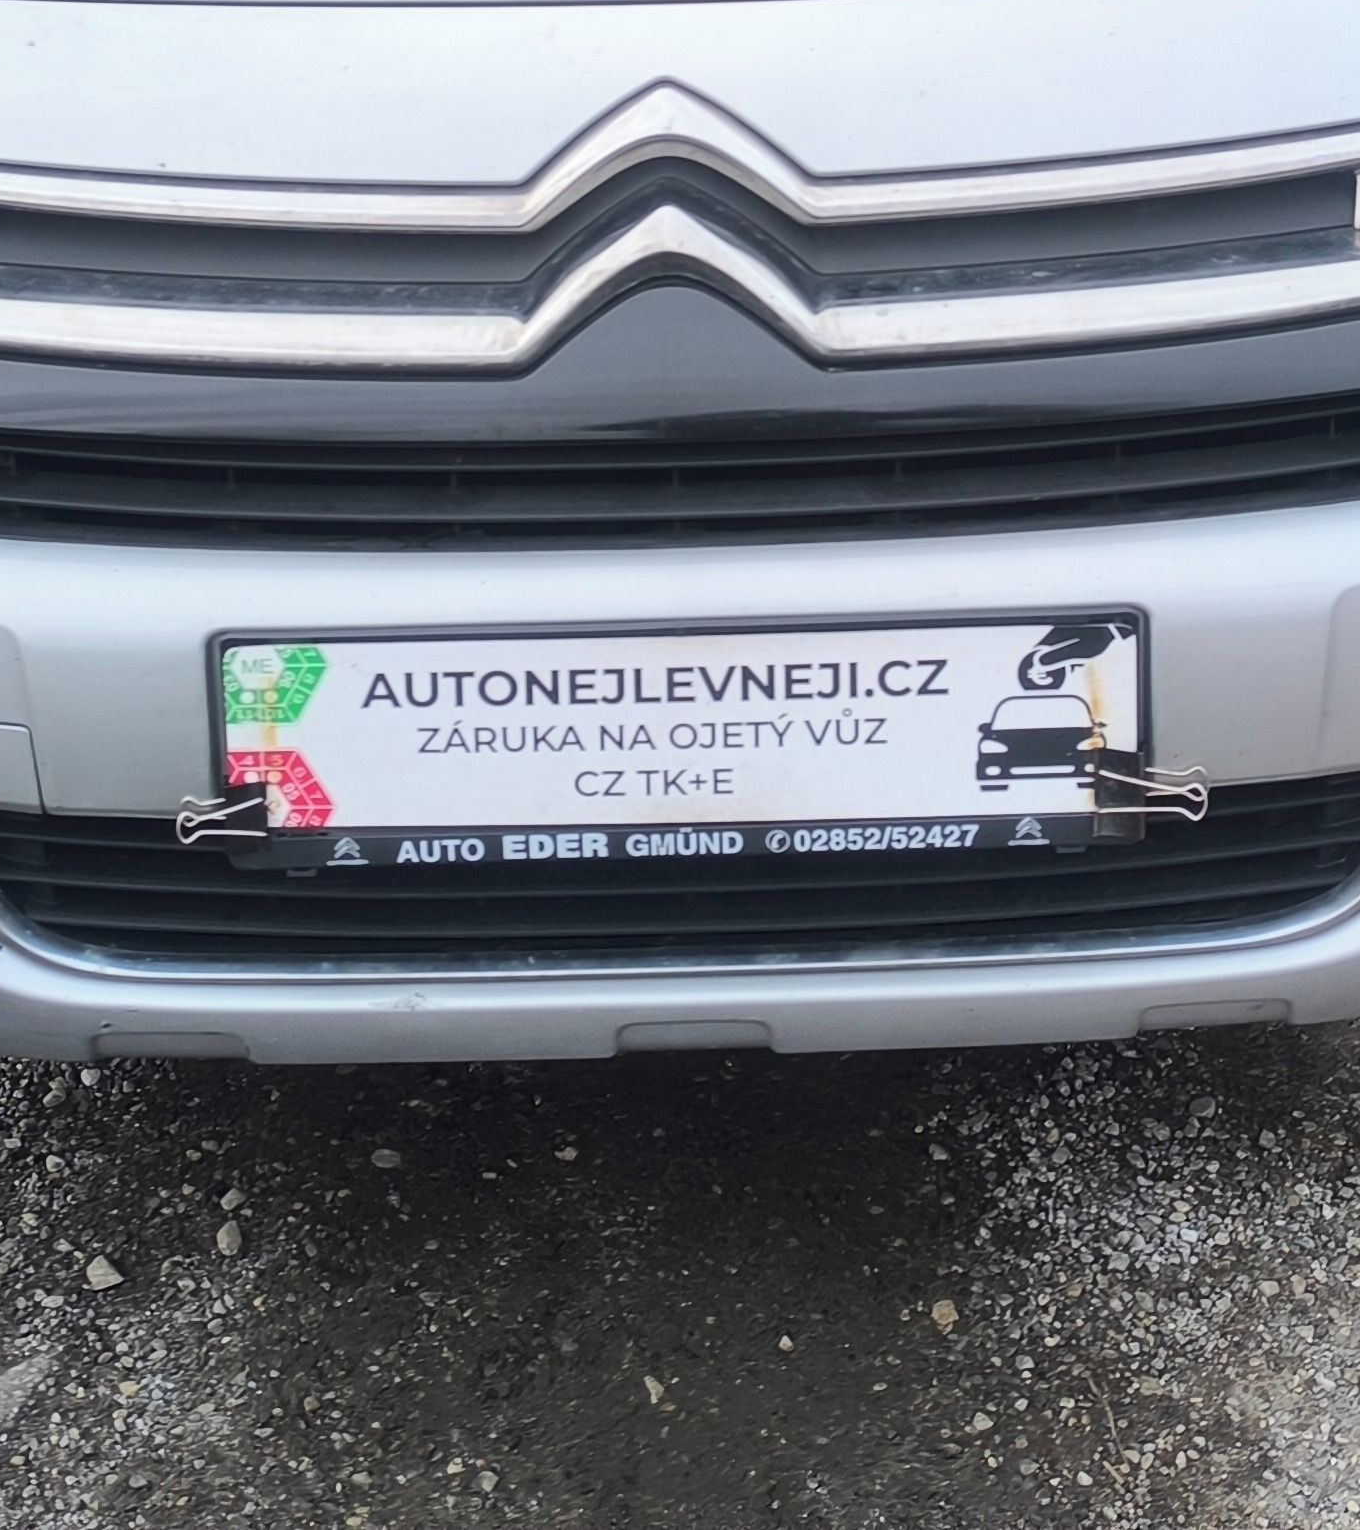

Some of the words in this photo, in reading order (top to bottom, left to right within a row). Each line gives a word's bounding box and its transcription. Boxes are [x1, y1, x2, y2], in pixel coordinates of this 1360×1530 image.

[361, 659, 949, 709] AUTONEJLEVNEJI.CZ
[417, 720, 586, 753] ZÁRUKA
[599, 724, 657, 751] NA
[669, 713, 794, 750] OJETÝ
[804, 708, 888, 746] VŮZ
[574, 770, 626, 797] CZ
[636, 768, 735, 796] TK+E
[396, 837, 485, 864] AUTO
[501, 832, 609, 860] EDER
[625, 826, 744, 857] GMÜND
